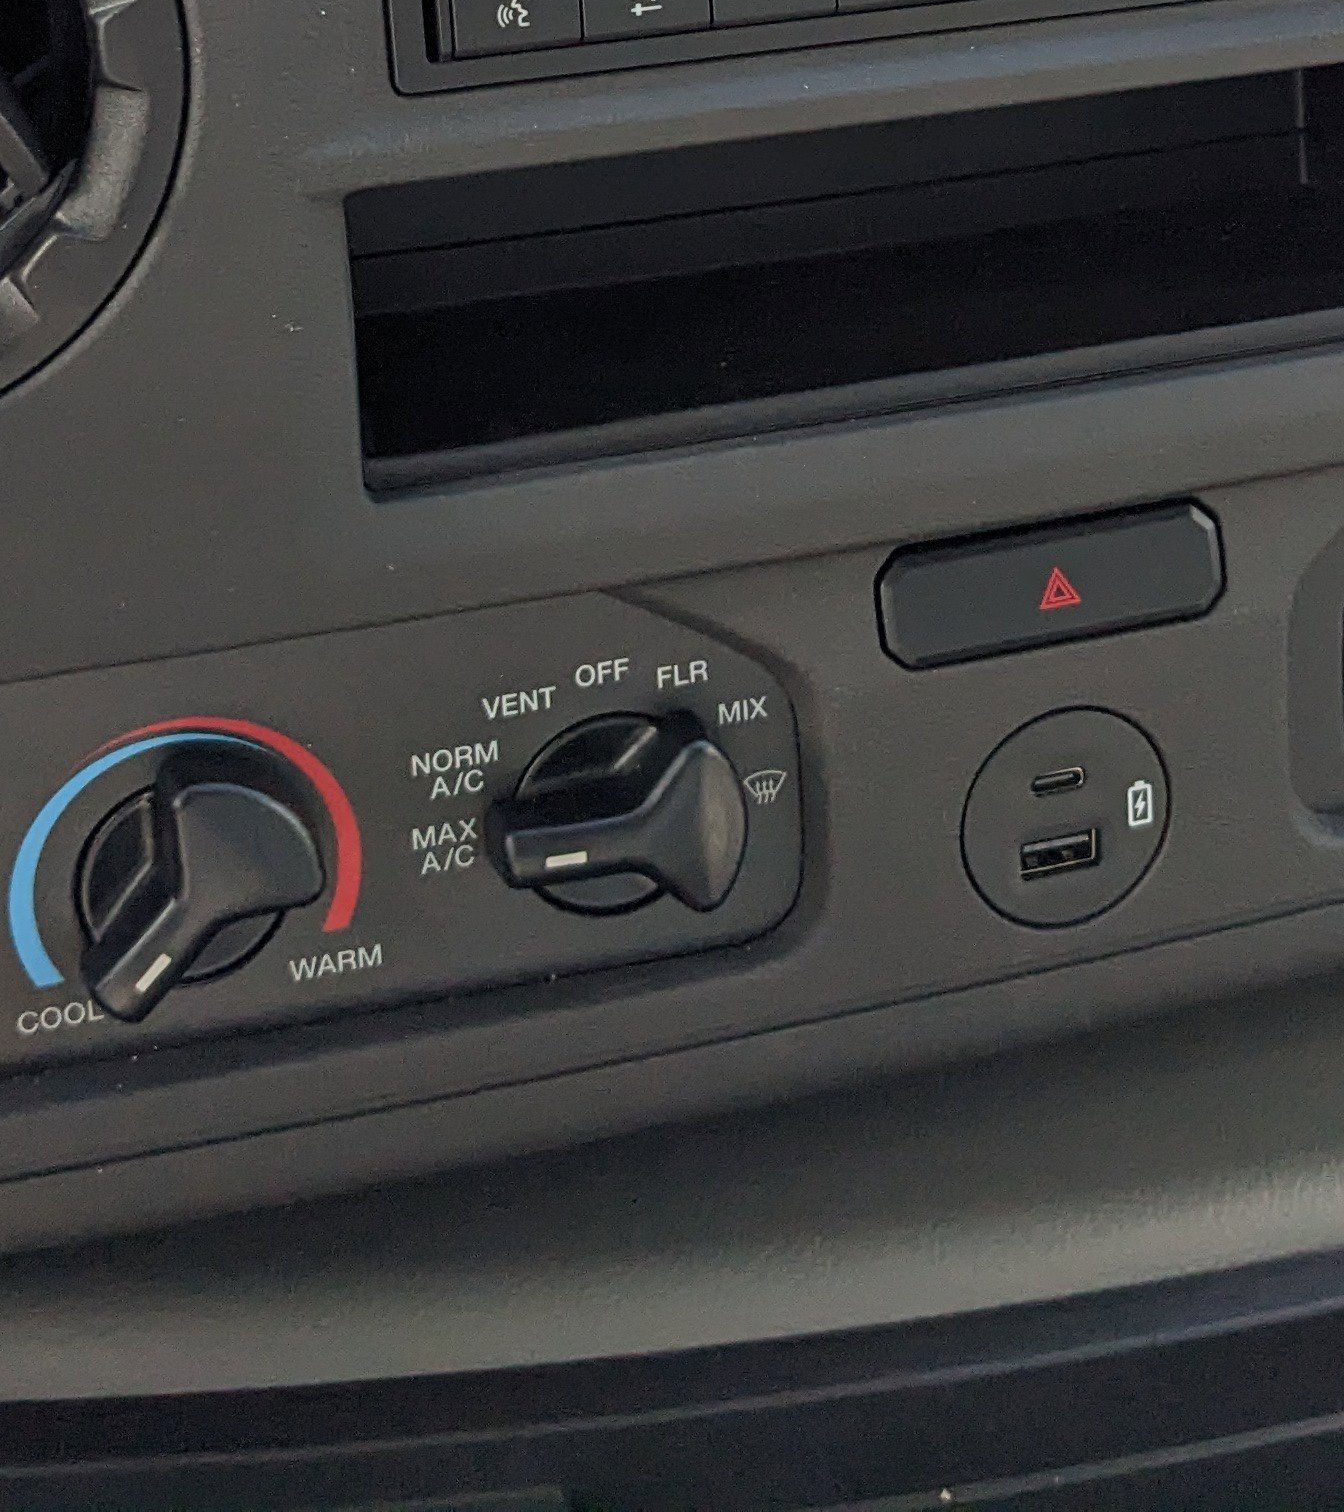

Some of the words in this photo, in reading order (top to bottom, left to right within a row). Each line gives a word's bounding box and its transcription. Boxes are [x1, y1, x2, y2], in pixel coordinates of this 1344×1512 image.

[574, 658, 630, 687] OFF
[656, 660, 709, 689] FLR
[481, 686, 556, 720] VENT
[718, 696, 768, 726] MIX
[410, 739, 500, 777] NORM
[430, 769, 485, 800] A/C
[411, 816, 479, 850] MAX
[420, 844, 475, 876] A/C
[288, 943, 383, 982] WARM
[16, 1000, 105, 1036] COOL
